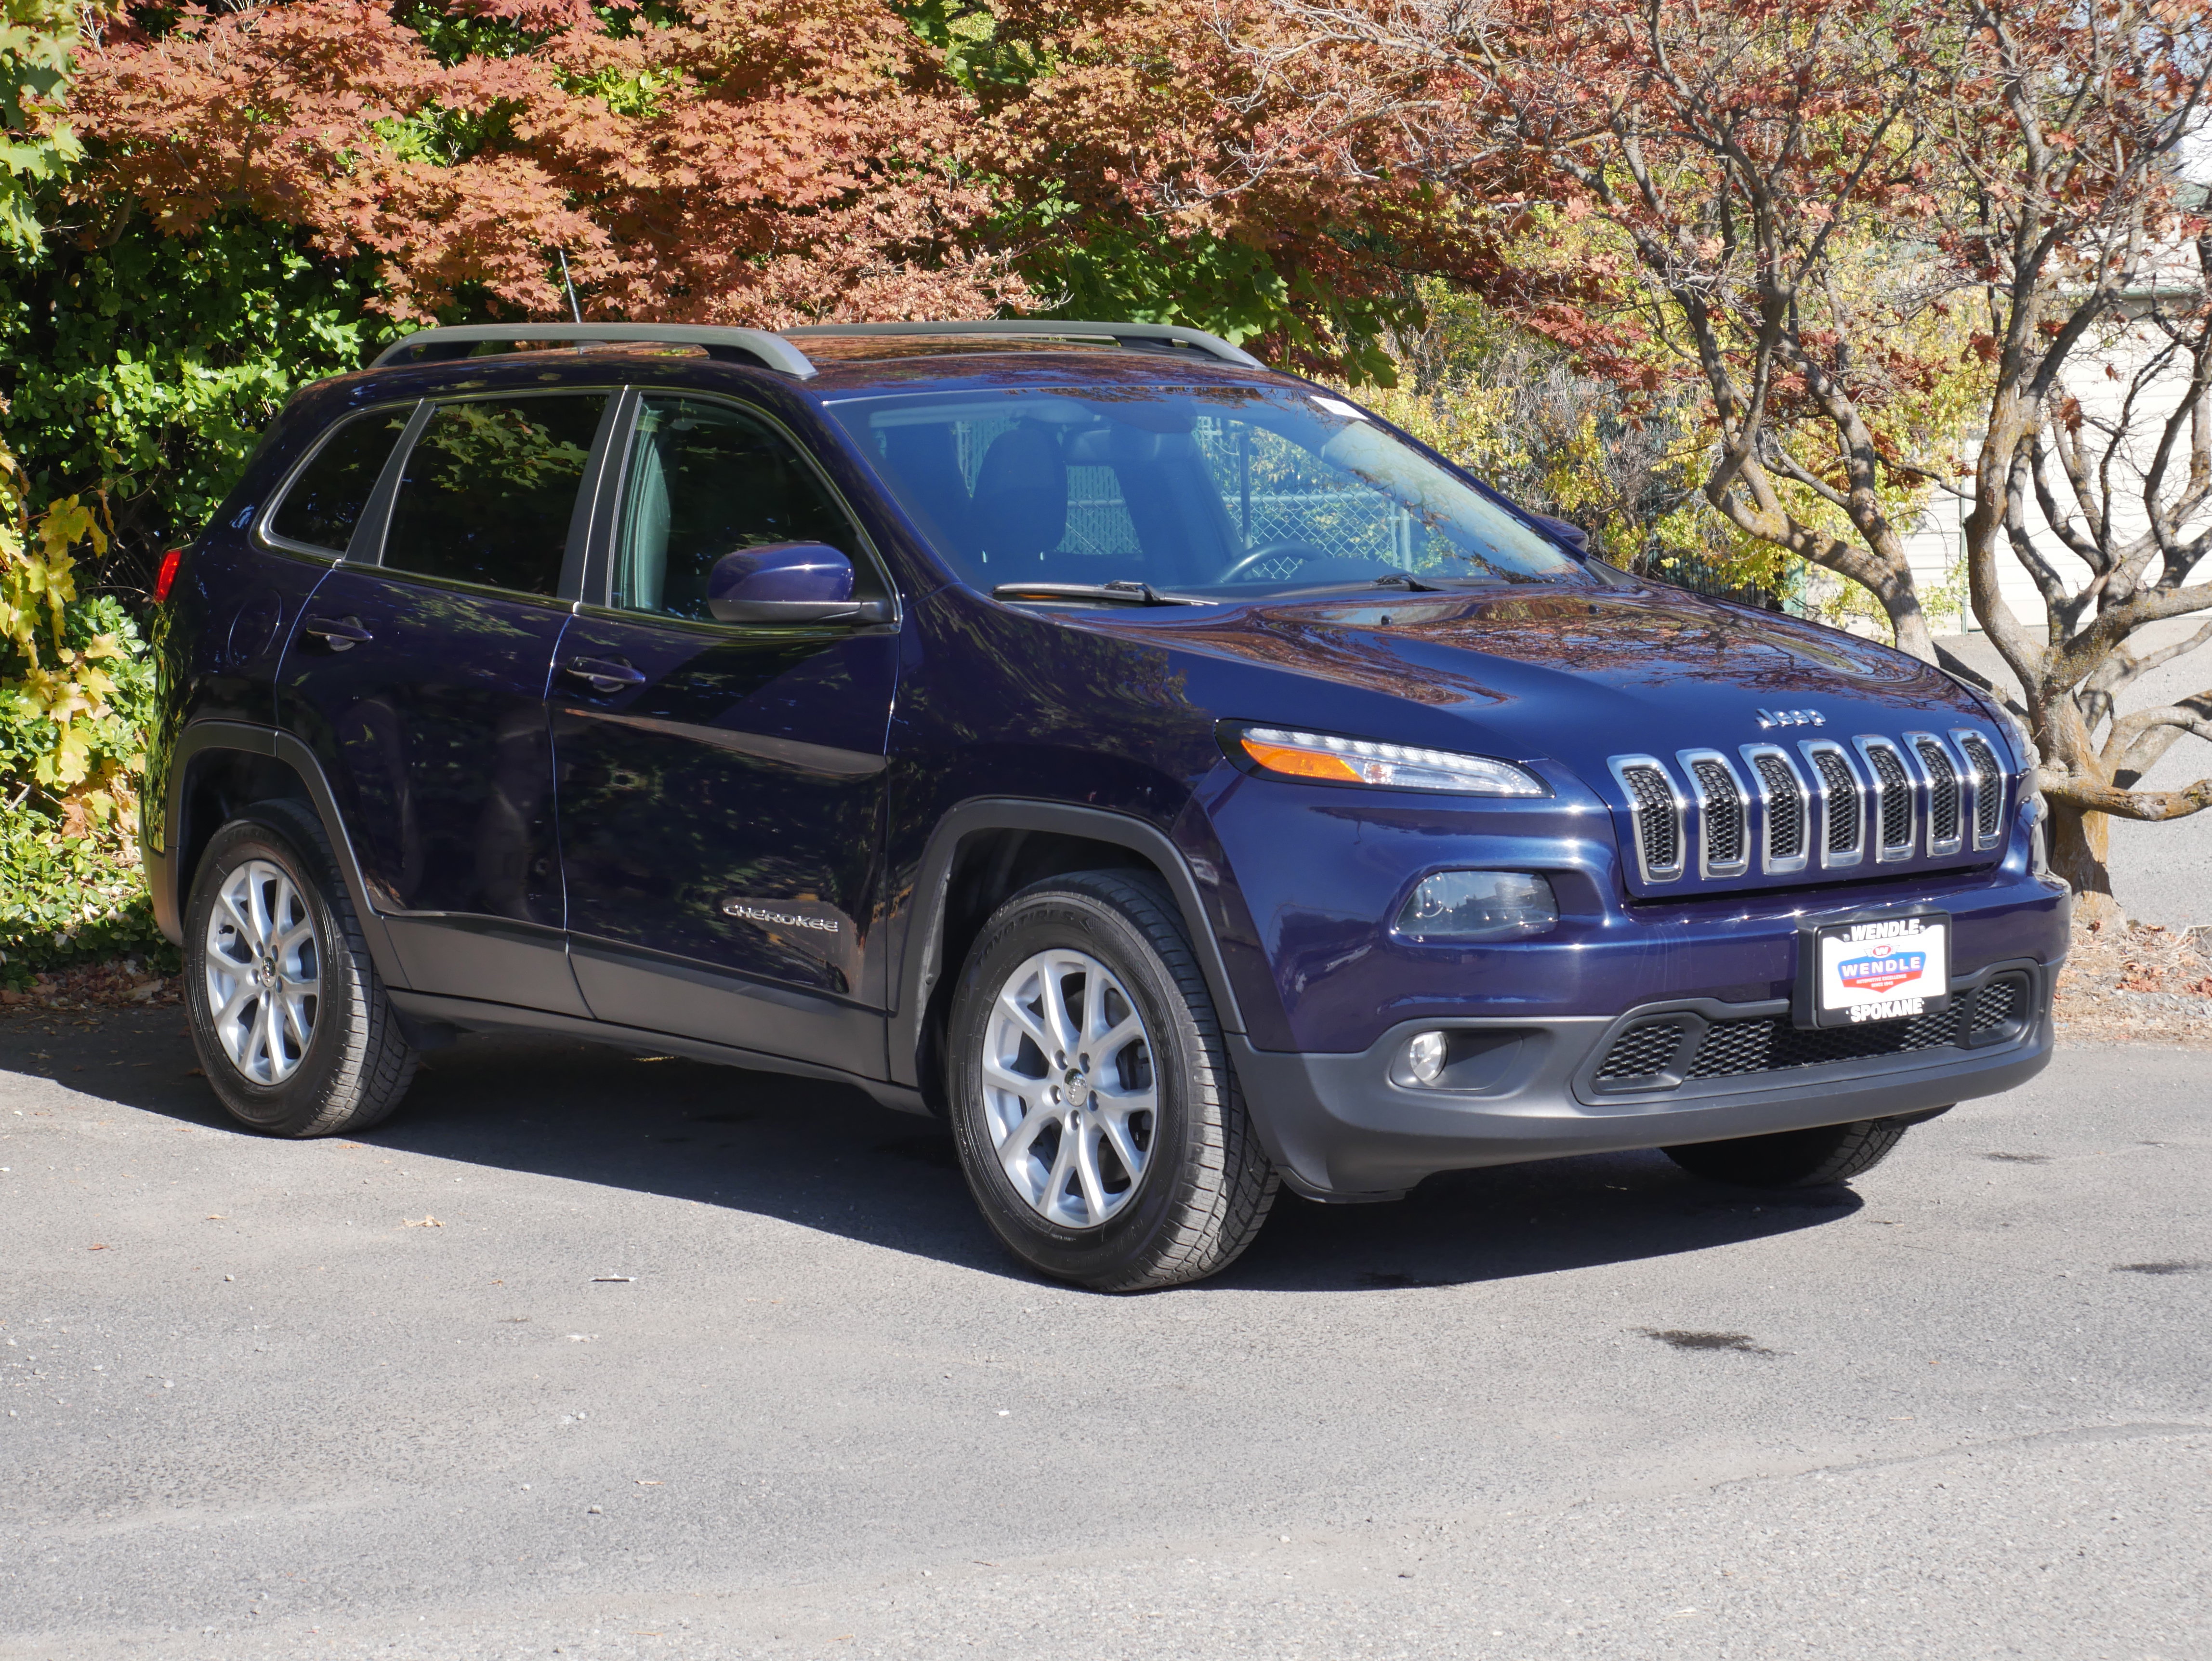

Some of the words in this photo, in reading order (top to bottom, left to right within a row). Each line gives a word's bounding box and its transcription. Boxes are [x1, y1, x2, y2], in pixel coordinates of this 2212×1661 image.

[1755, 708, 1826, 727] Jeep
[723, 905, 838, 932] CHEROKEE
[1851, 919, 1920, 941] WENDLE
[1875, 947, 1889, 955] W
[1842, 957, 1921, 977] WENDLE
[1882, 974, 1907, 982] EXCELLENCE
[1850, 998, 1923, 1022] SPOKANE
